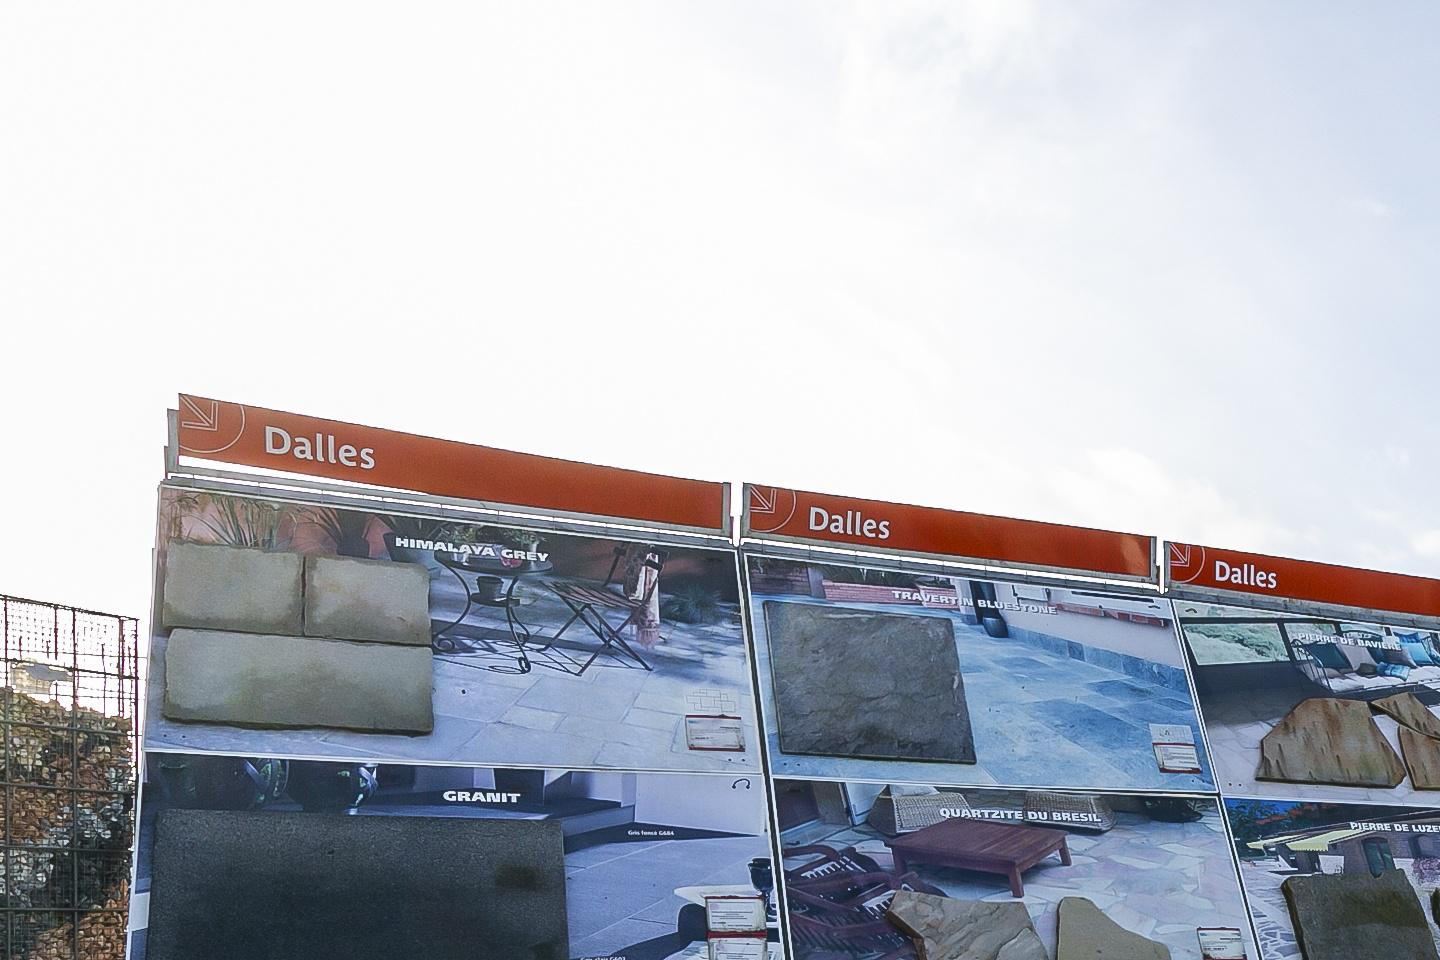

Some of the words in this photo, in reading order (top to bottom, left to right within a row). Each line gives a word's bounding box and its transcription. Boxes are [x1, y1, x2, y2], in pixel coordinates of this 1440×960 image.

[265, 425, 375, 469] Dalles
[809, 506, 890, 539] Dalles
[395, 537, 495, 557] HIMALAYA
[501, 549, 549, 562] GREY
[1215, 560, 1277, 589] Dalles
[892, 590, 973, 607] TRAVERTIN
[978, 599, 1057, 615] BLUESTONE
[1298, 632, 1337, 643] PIERRE
[1339, 637, 1355, 645] DE
[443, 790, 521, 803] GRANIT
[939, 807, 1024, 820] QUARTZITE
[1028, 810, 1048, 821] DU
[1053, 811, 1101, 822] BRESIL
[1350, 821, 1391, 831] PIERRE
[1394, 823, 1410, 832] DE
